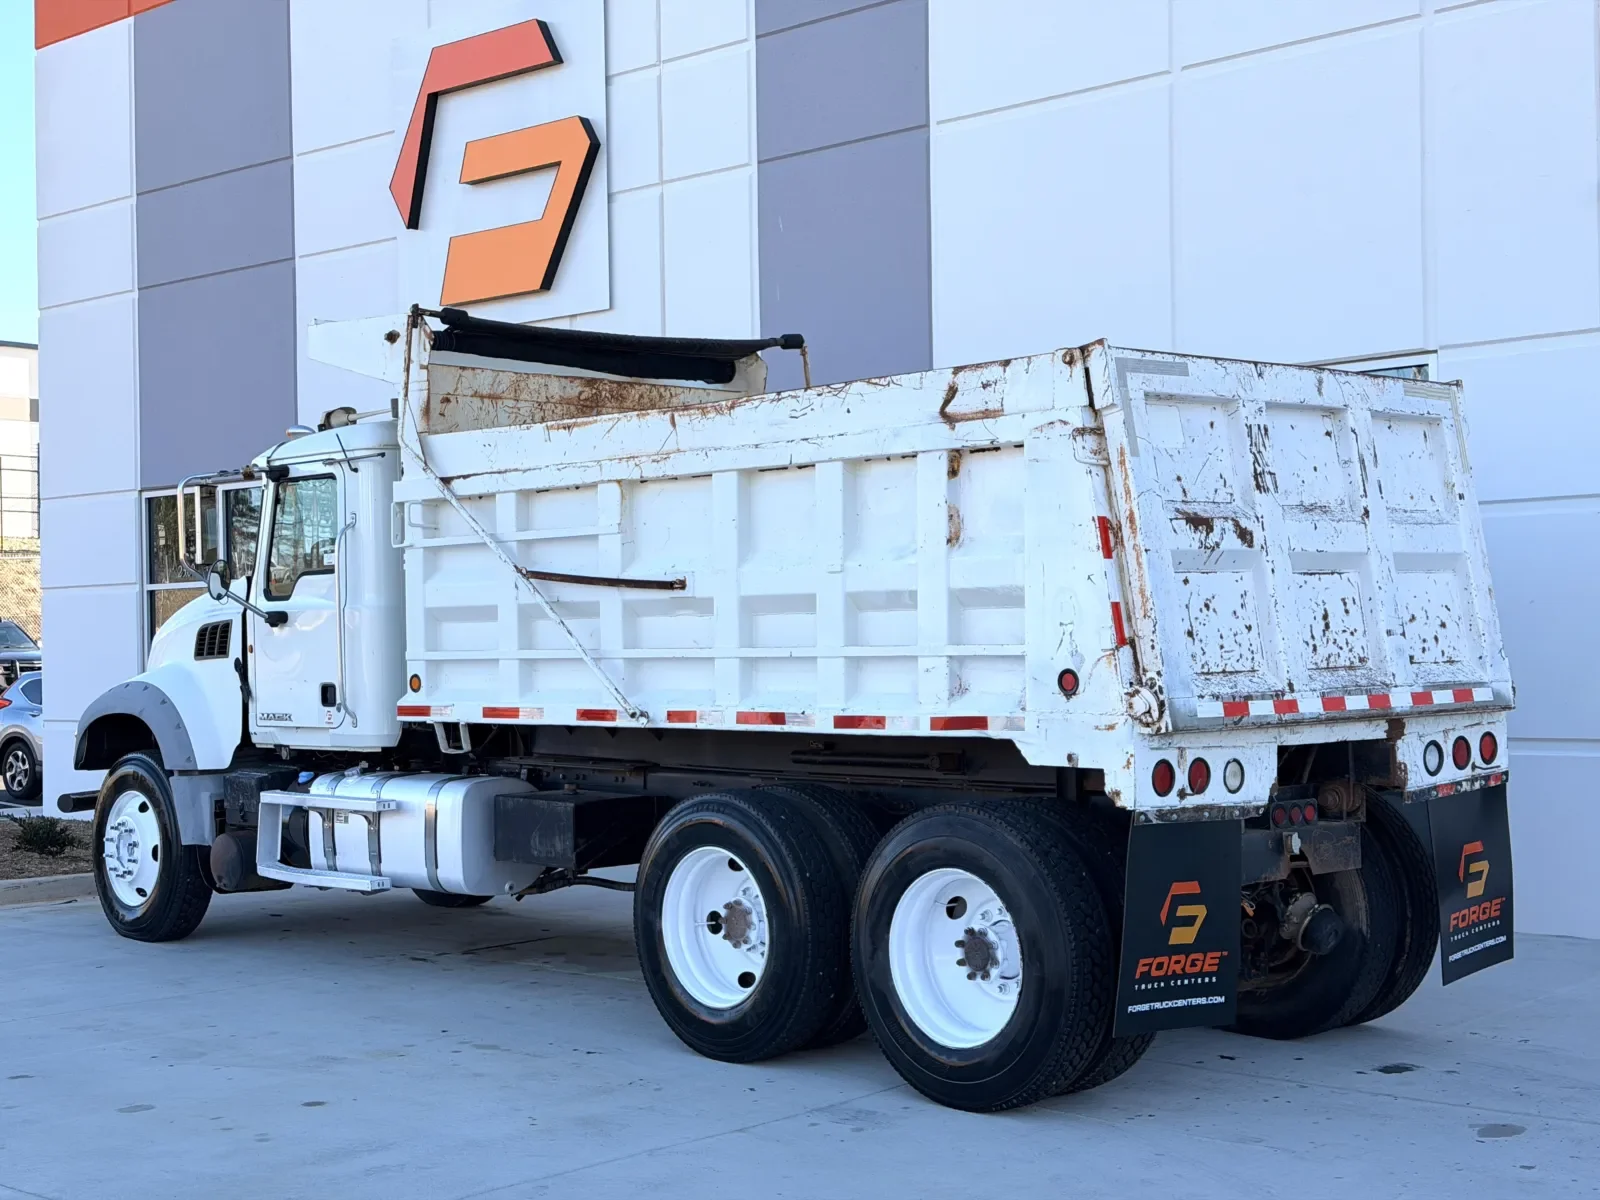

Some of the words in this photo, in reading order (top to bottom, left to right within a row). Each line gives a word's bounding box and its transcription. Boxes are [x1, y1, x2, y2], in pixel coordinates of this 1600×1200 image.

[259, 713, 293, 722] MACK
[1134, 981, 1165, 991] TRUCK
[1170, 976, 1217, 986] CENTERS
[1127, 996, 1226, 1014] FORGETRUCKCENTERS.COM
